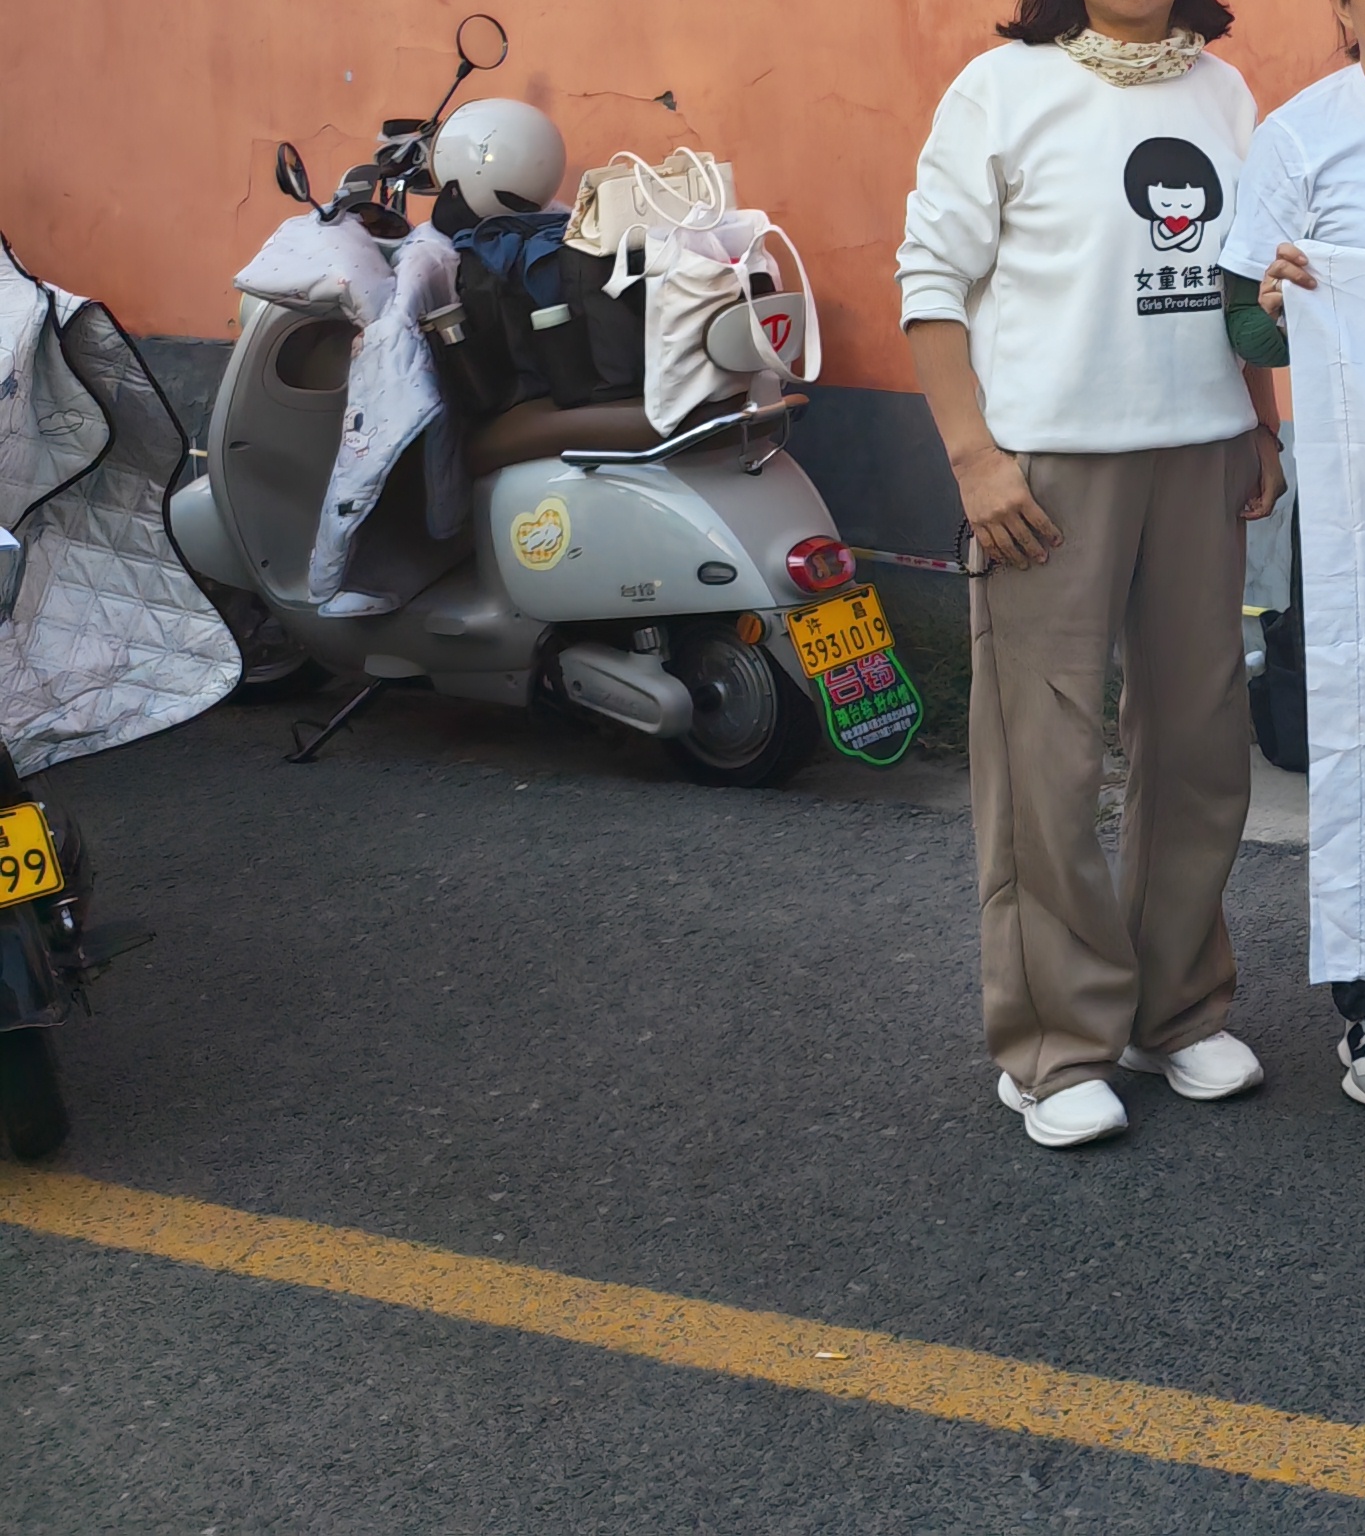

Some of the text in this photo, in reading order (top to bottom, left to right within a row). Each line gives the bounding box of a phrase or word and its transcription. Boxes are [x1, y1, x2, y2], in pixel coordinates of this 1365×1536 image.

[1133, 263, 1222, 292] 女童保护
[1164, 295, 1222, 310] Protection
[802, 617, 886, 669] 3931019
